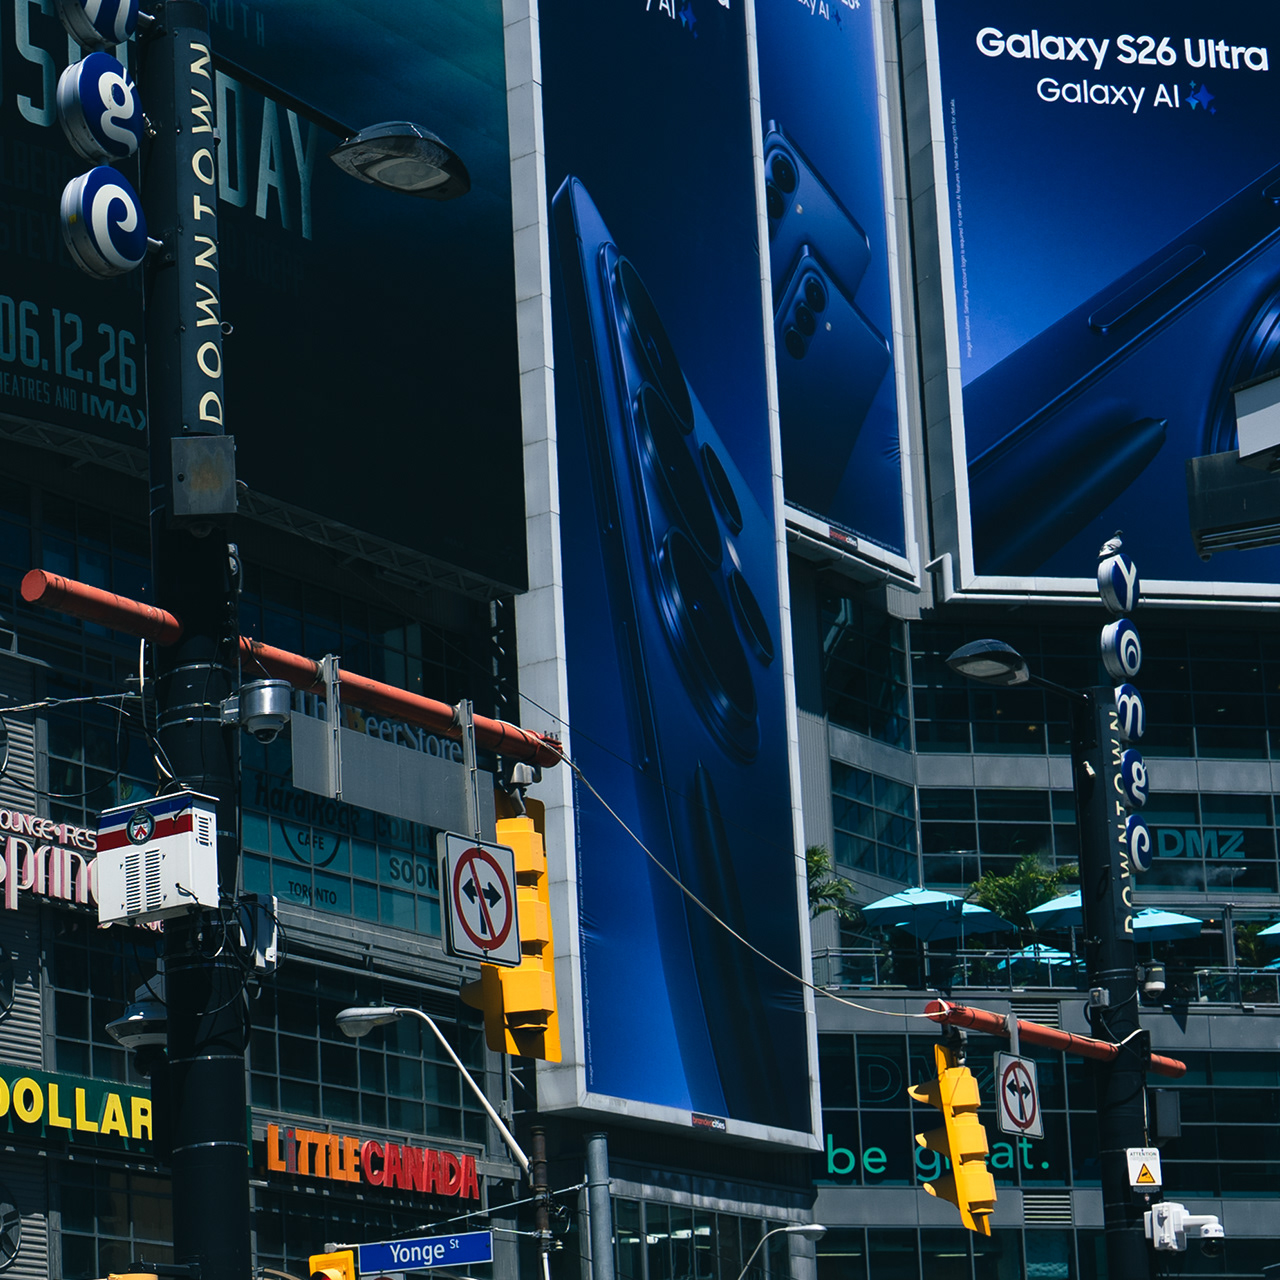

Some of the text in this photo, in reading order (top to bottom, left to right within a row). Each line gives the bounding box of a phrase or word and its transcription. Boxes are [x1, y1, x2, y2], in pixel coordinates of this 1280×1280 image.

[976, 27, 1269, 72] Galaxy S26 Ultra
[1037, 77, 1180, 114] Galaxy AI
[215, 70, 318, 241] DAY
[189, 41, 224, 426] DOWNTOWN
[962, 290, 970, 314] Samsung
[53, 385, 78, 413] AND
[297, 831, 325, 850] CAFE
[1158, 828, 1246, 859] DMZ
[389, 855, 438, 895] SOON
[289, 879, 337, 906] TORONTO
[692, 1115, 725, 1130] brandedcities
[361, 1139, 480, 1200] CANADA
[827, 1133, 886, 1175] be
[389, 1238, 460, 1265] Yonge St
